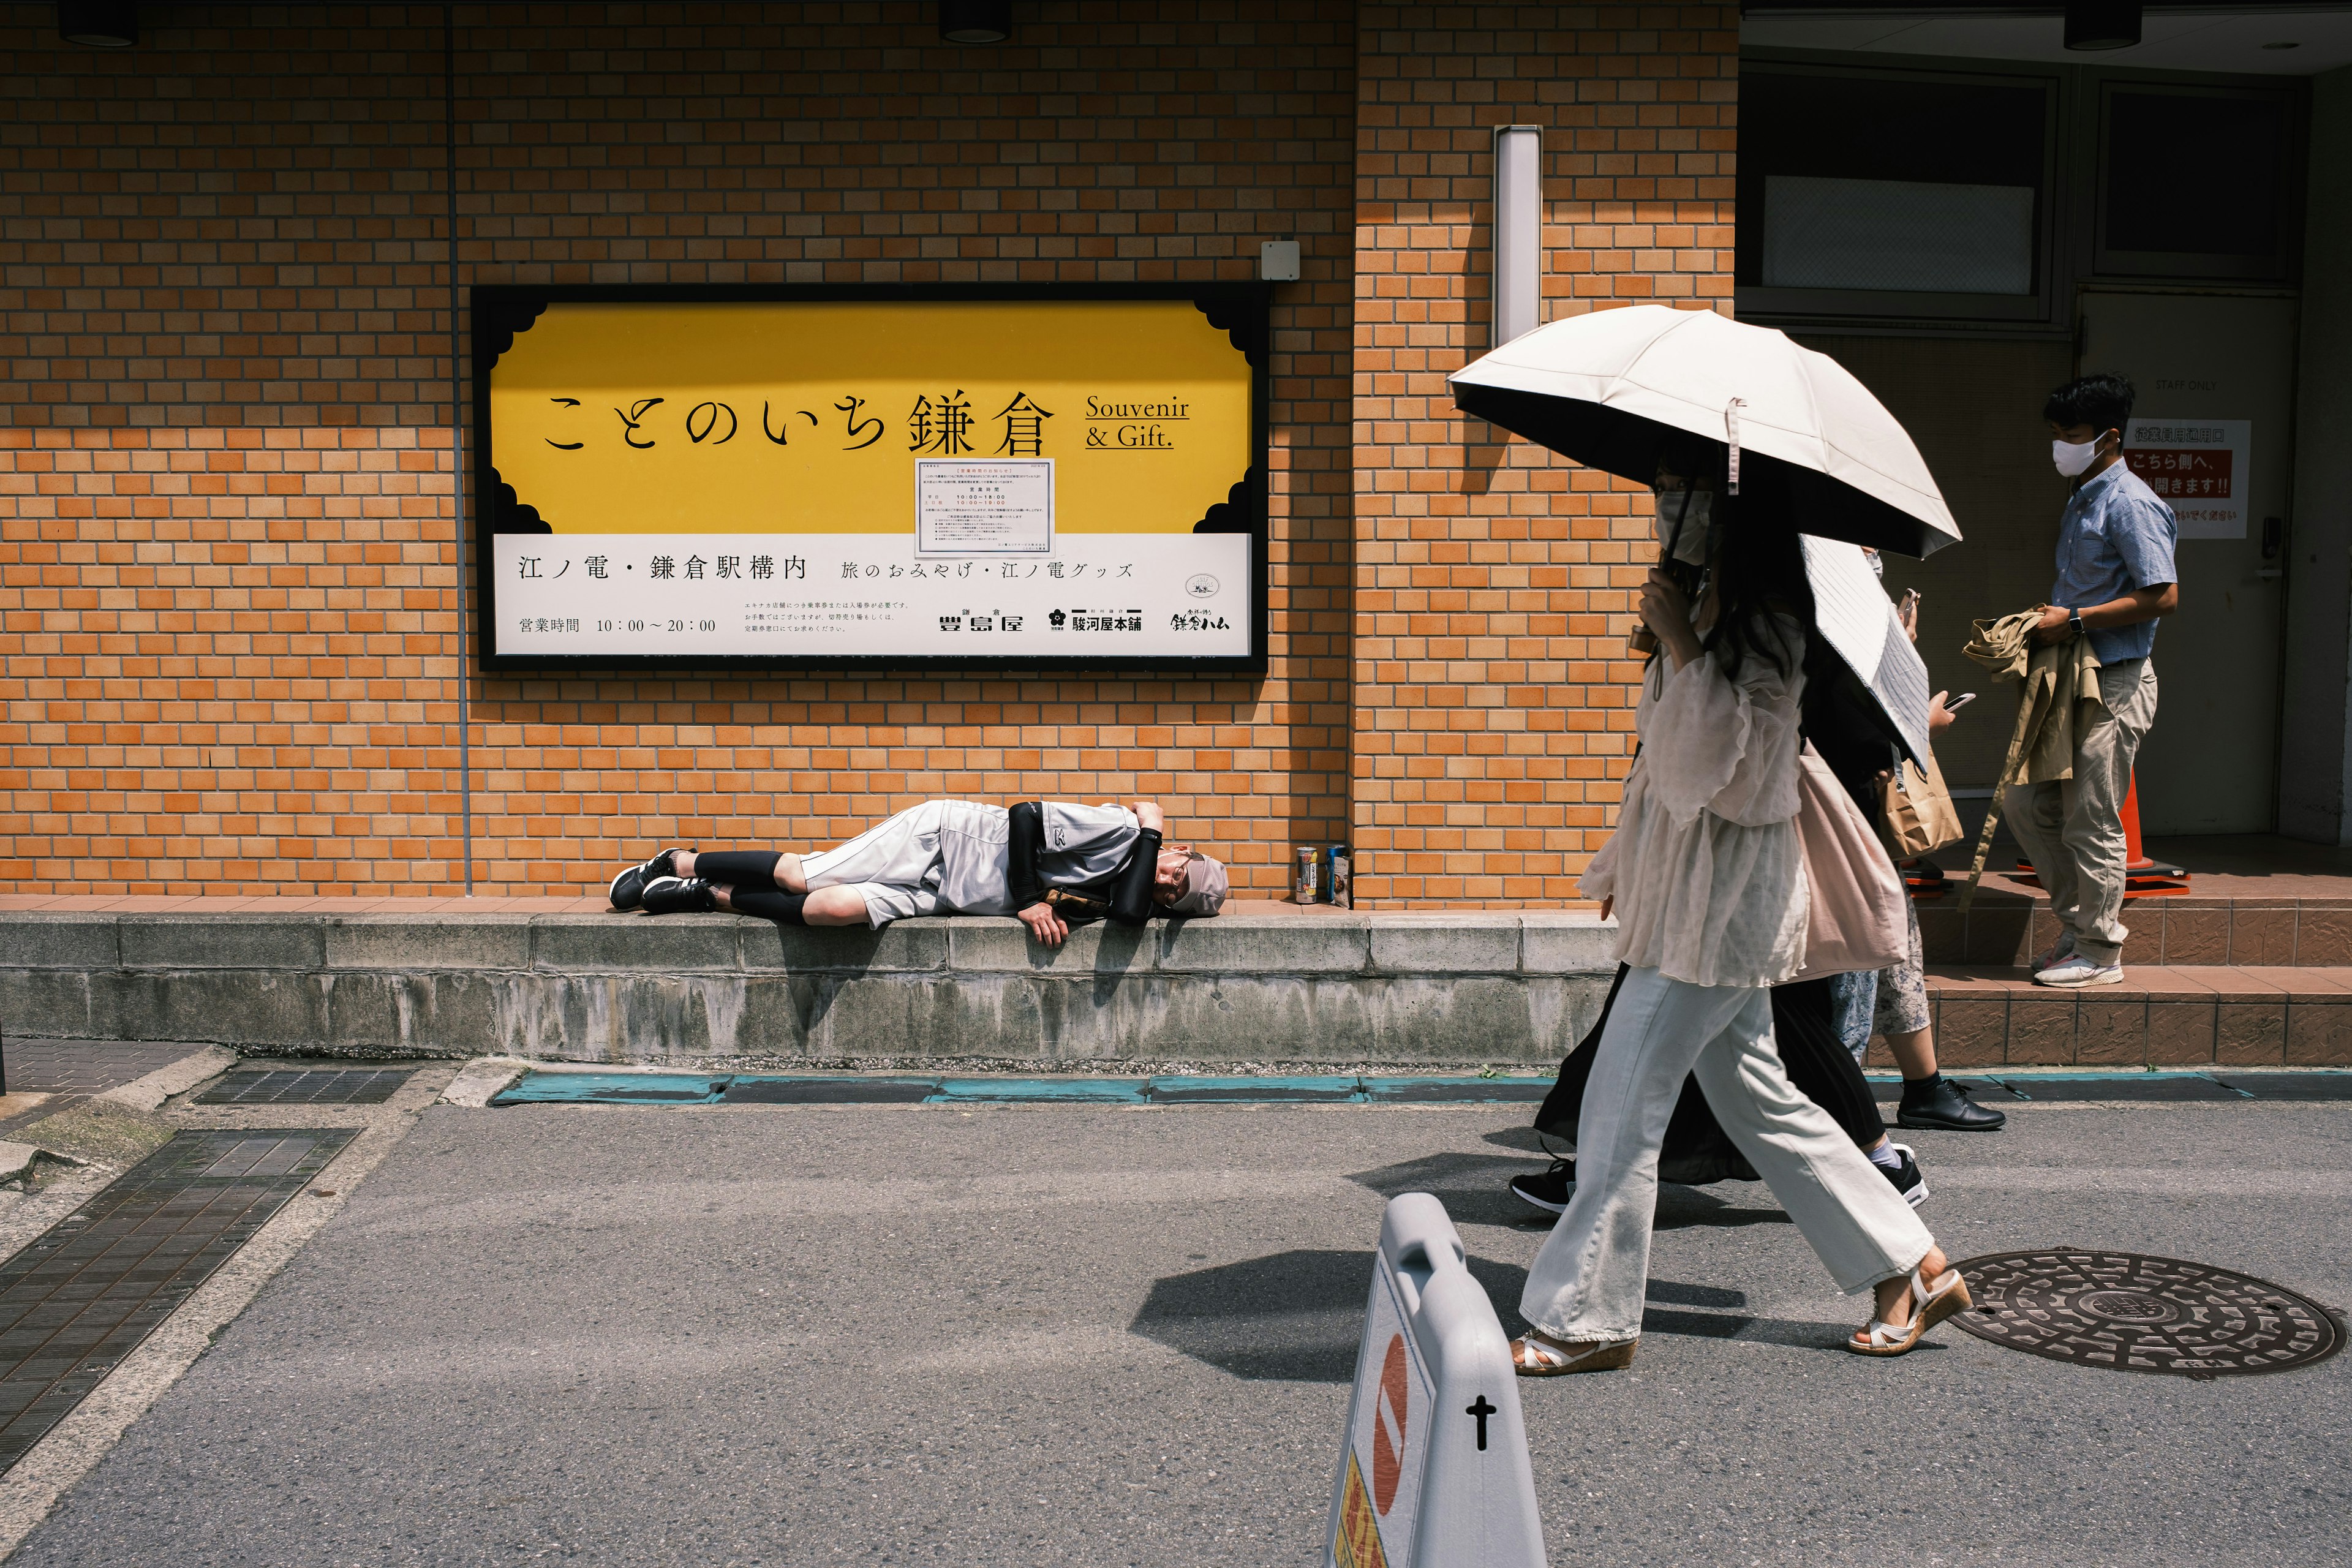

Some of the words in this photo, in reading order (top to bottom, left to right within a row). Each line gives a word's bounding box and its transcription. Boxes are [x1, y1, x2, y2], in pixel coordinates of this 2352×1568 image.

[2156, 380, 2185, 390] STAFF
[2188, 380, 2217, 391] ONLY
[1086, 396, 1188, 417] Souvenir
[545, 389, 1055, 456] ことのいち鎌倉
[1086, 426, 1107, 447] &
[1117, 424, 1172, 447] Gift.
[2135, 427, 2225, 443] 従業員用通用口
[2132, 453, 2214, 470] こちら側へ、
[518, 554, 806, 580] 江ノ電・鎌倉駅構内
[840, 561, 1133, 579] 旅のおみやげ・江ノ電グッズ
[519, 617, 580, 633] 営業時間
[940, 616, 1023, 631] 豊島屋
[1072, 616, 1142, 631] 駿河屋本舗
[1170, 613, 1230, 632] 鎌倉ハム
